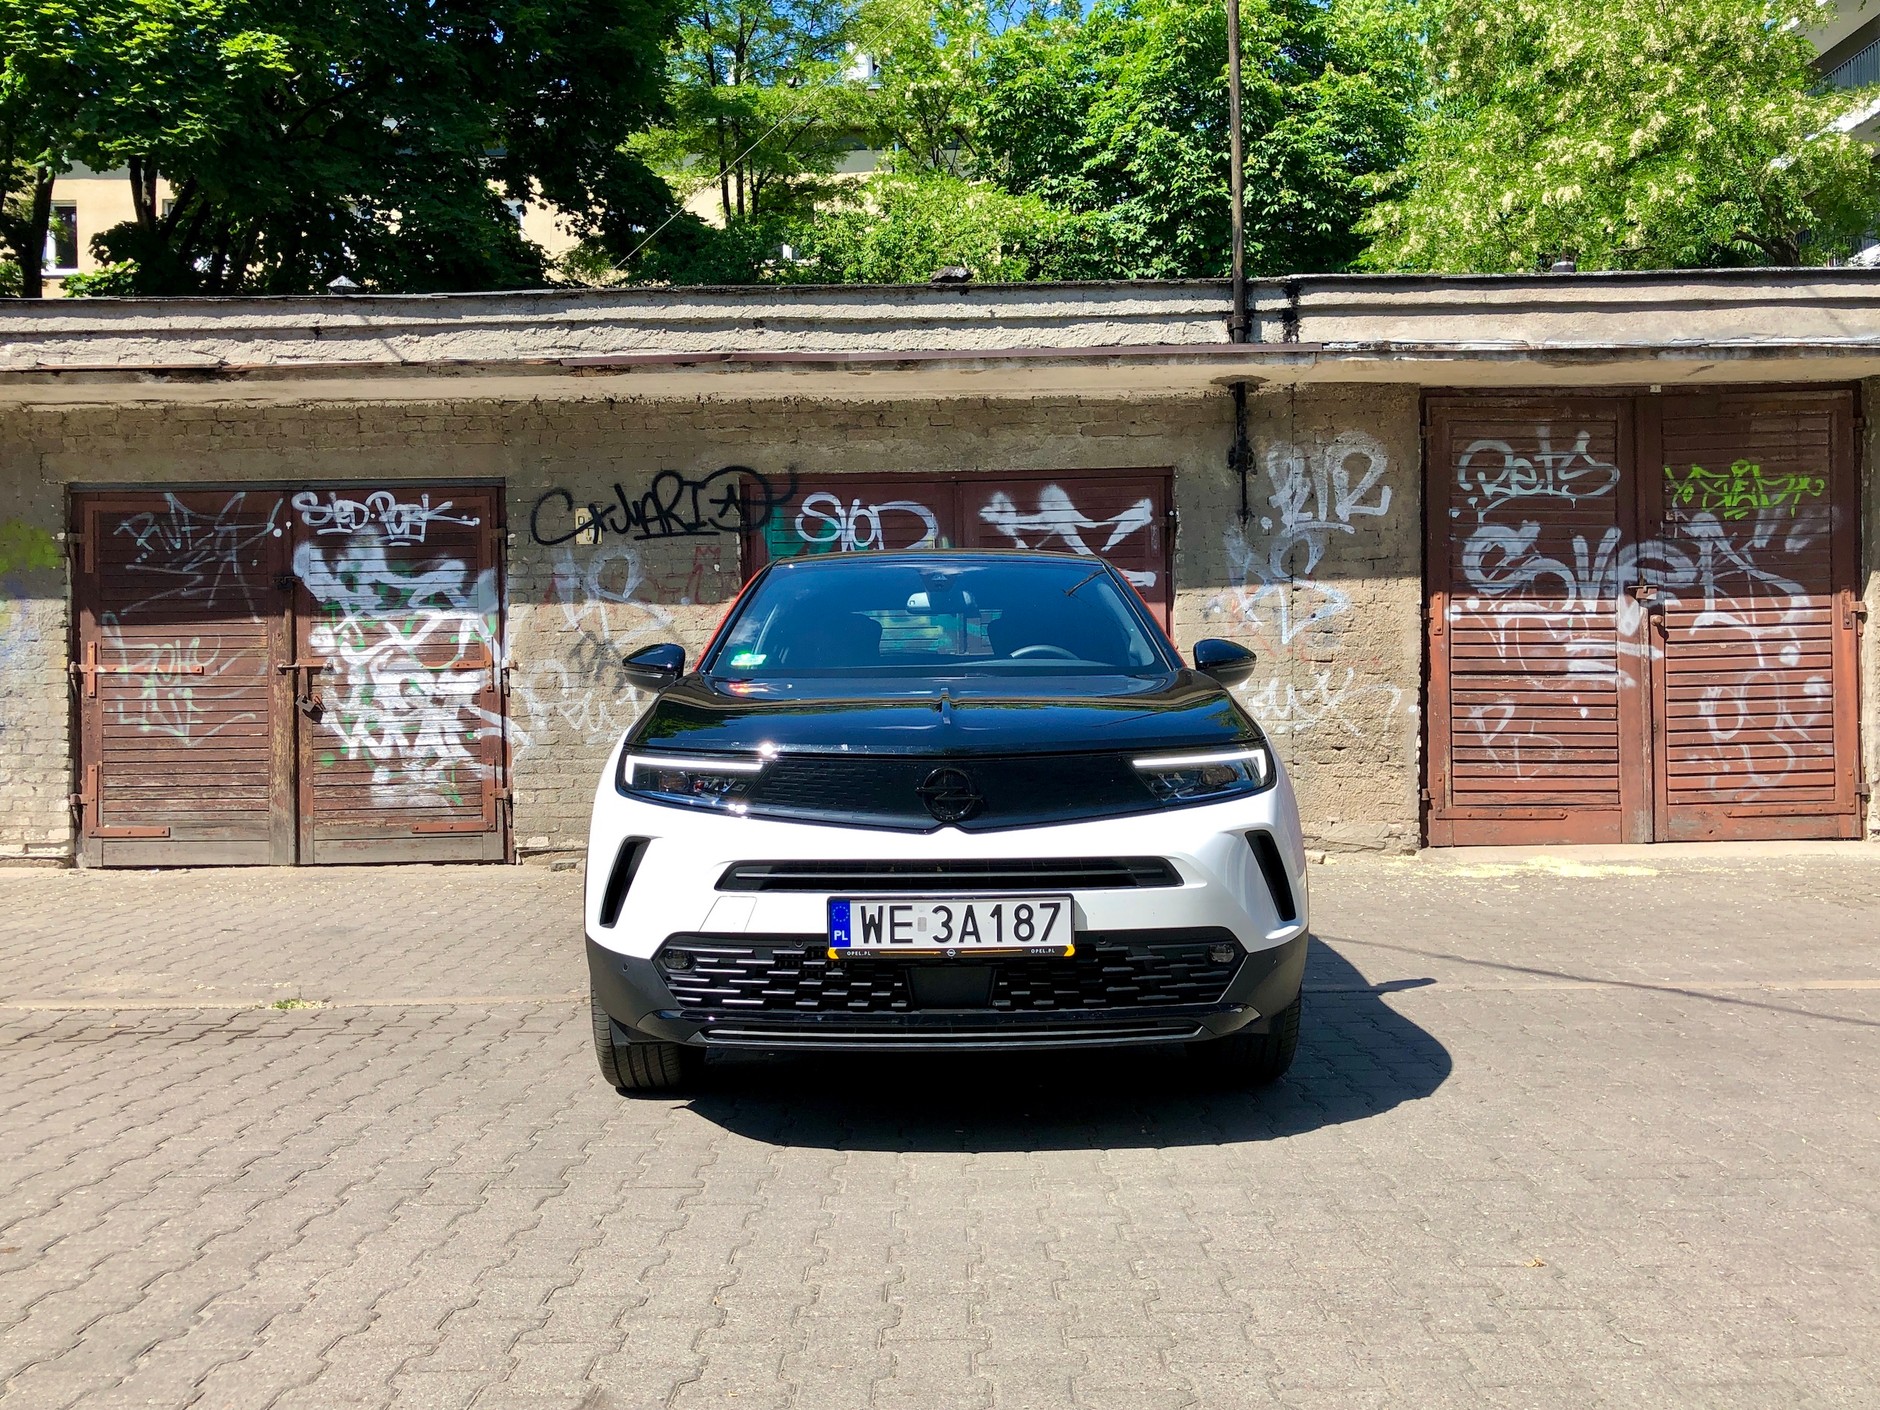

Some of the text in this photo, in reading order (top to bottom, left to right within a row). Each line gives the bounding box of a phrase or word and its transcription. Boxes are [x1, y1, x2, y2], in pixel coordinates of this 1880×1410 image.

[834, 930, 848, 941] PL
[860, 902, 1061, 944] WE 3A187
